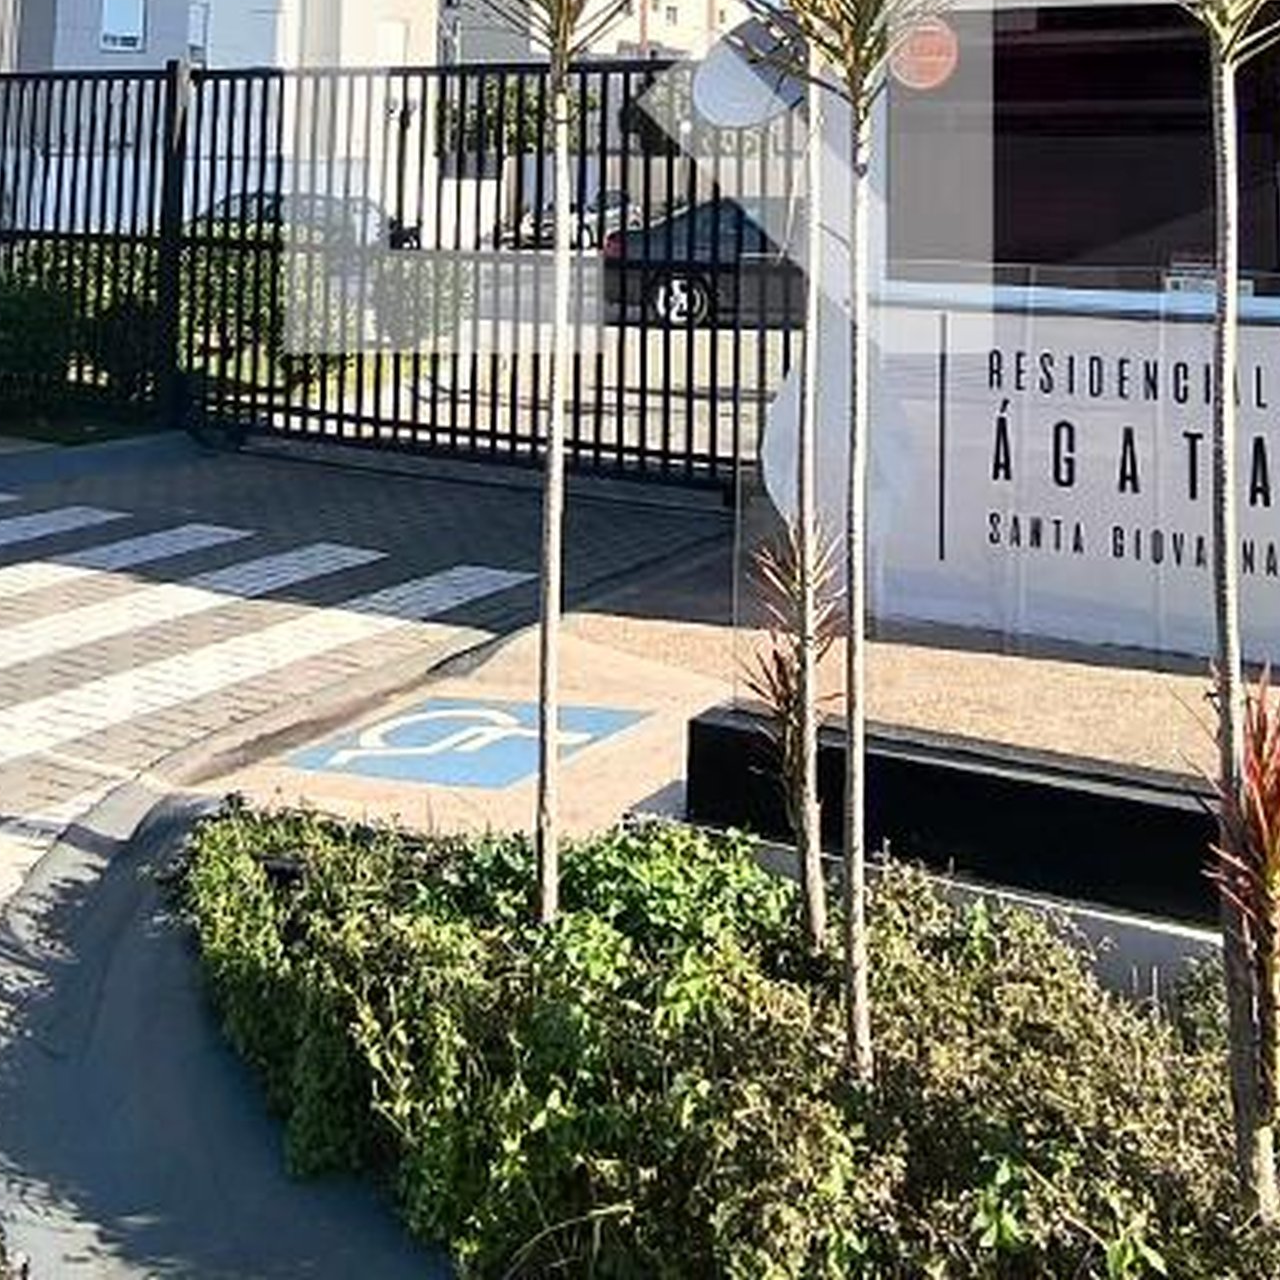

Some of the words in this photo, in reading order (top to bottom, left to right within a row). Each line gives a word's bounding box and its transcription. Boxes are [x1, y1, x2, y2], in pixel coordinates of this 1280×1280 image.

[991, 398, 1272, 507] ÁGATA
[988, 512, 1084, 554] SANTA
[1112, 526, 1278, 577] GIOVANA
